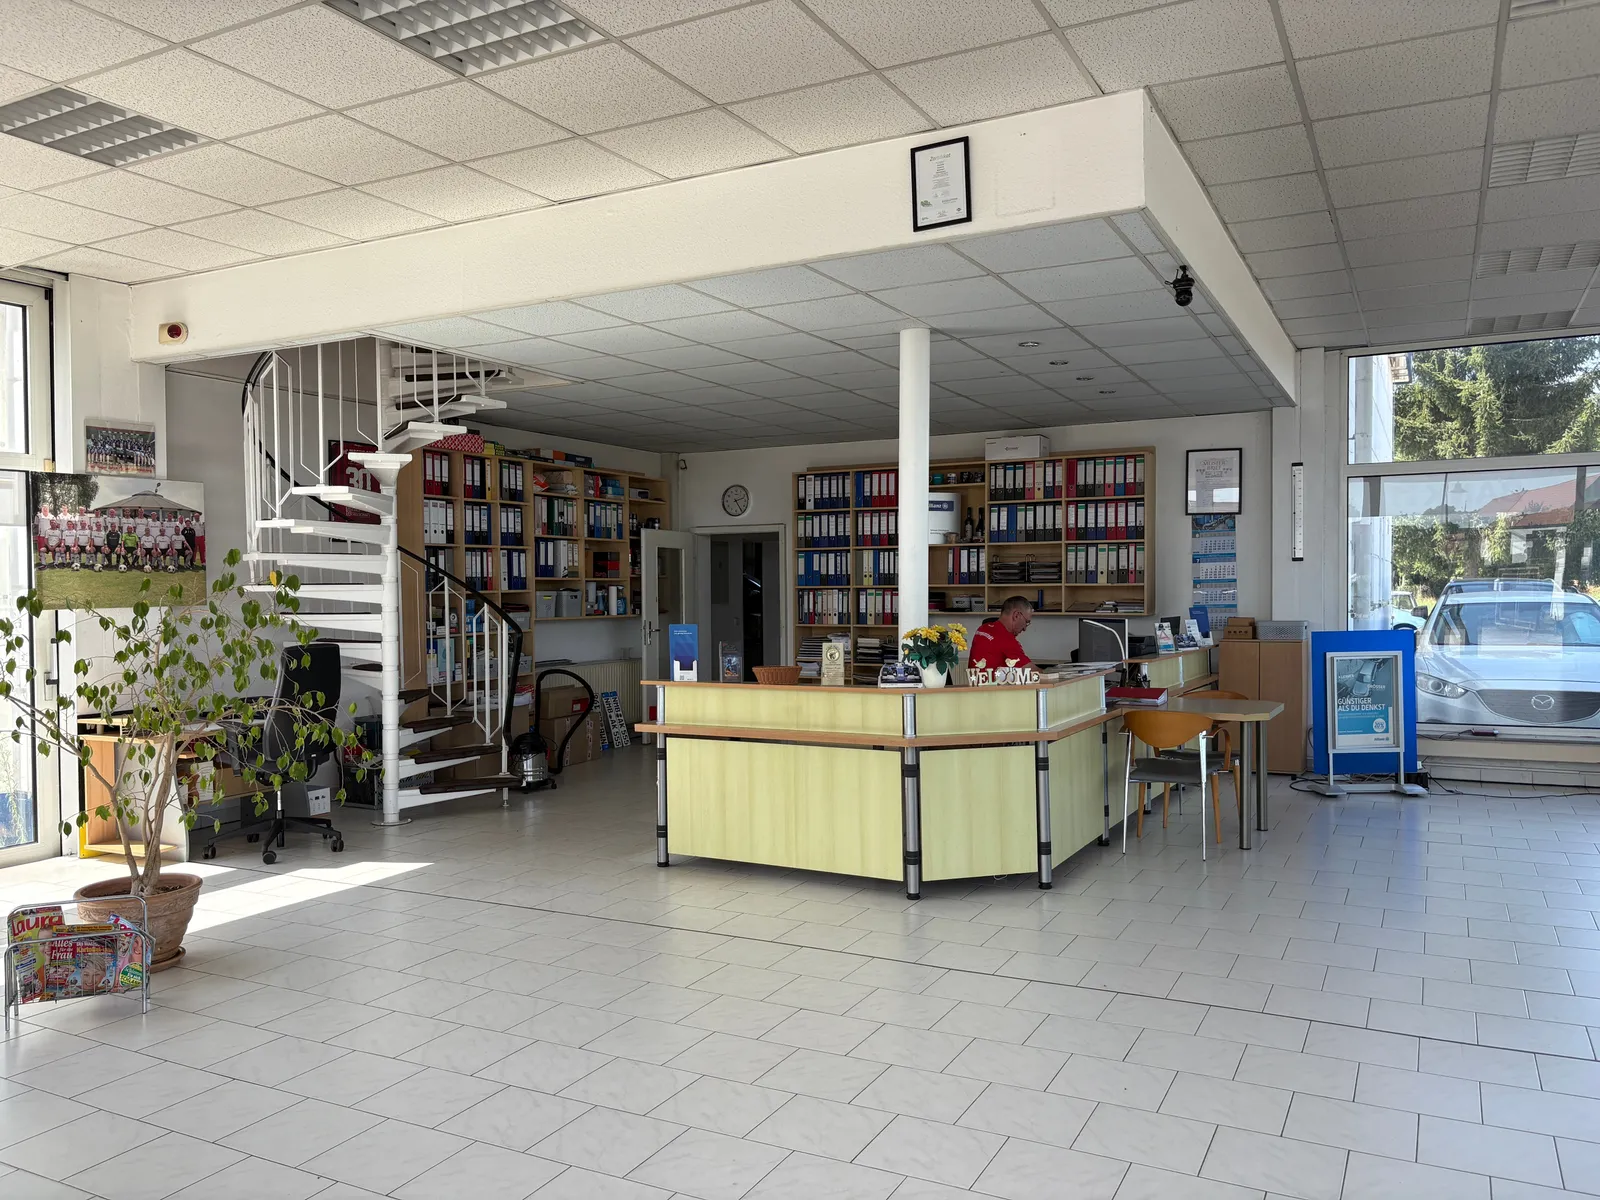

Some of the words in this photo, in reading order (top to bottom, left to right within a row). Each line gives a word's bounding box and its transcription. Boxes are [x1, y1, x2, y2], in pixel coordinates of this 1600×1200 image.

[1338, 697, 1372, 705] GÜNSTIGER
[1361, 703, 1386, 711] DENKST
[11, 915, 65, 937] Laura
[51, 949, 73, 960] Frau
